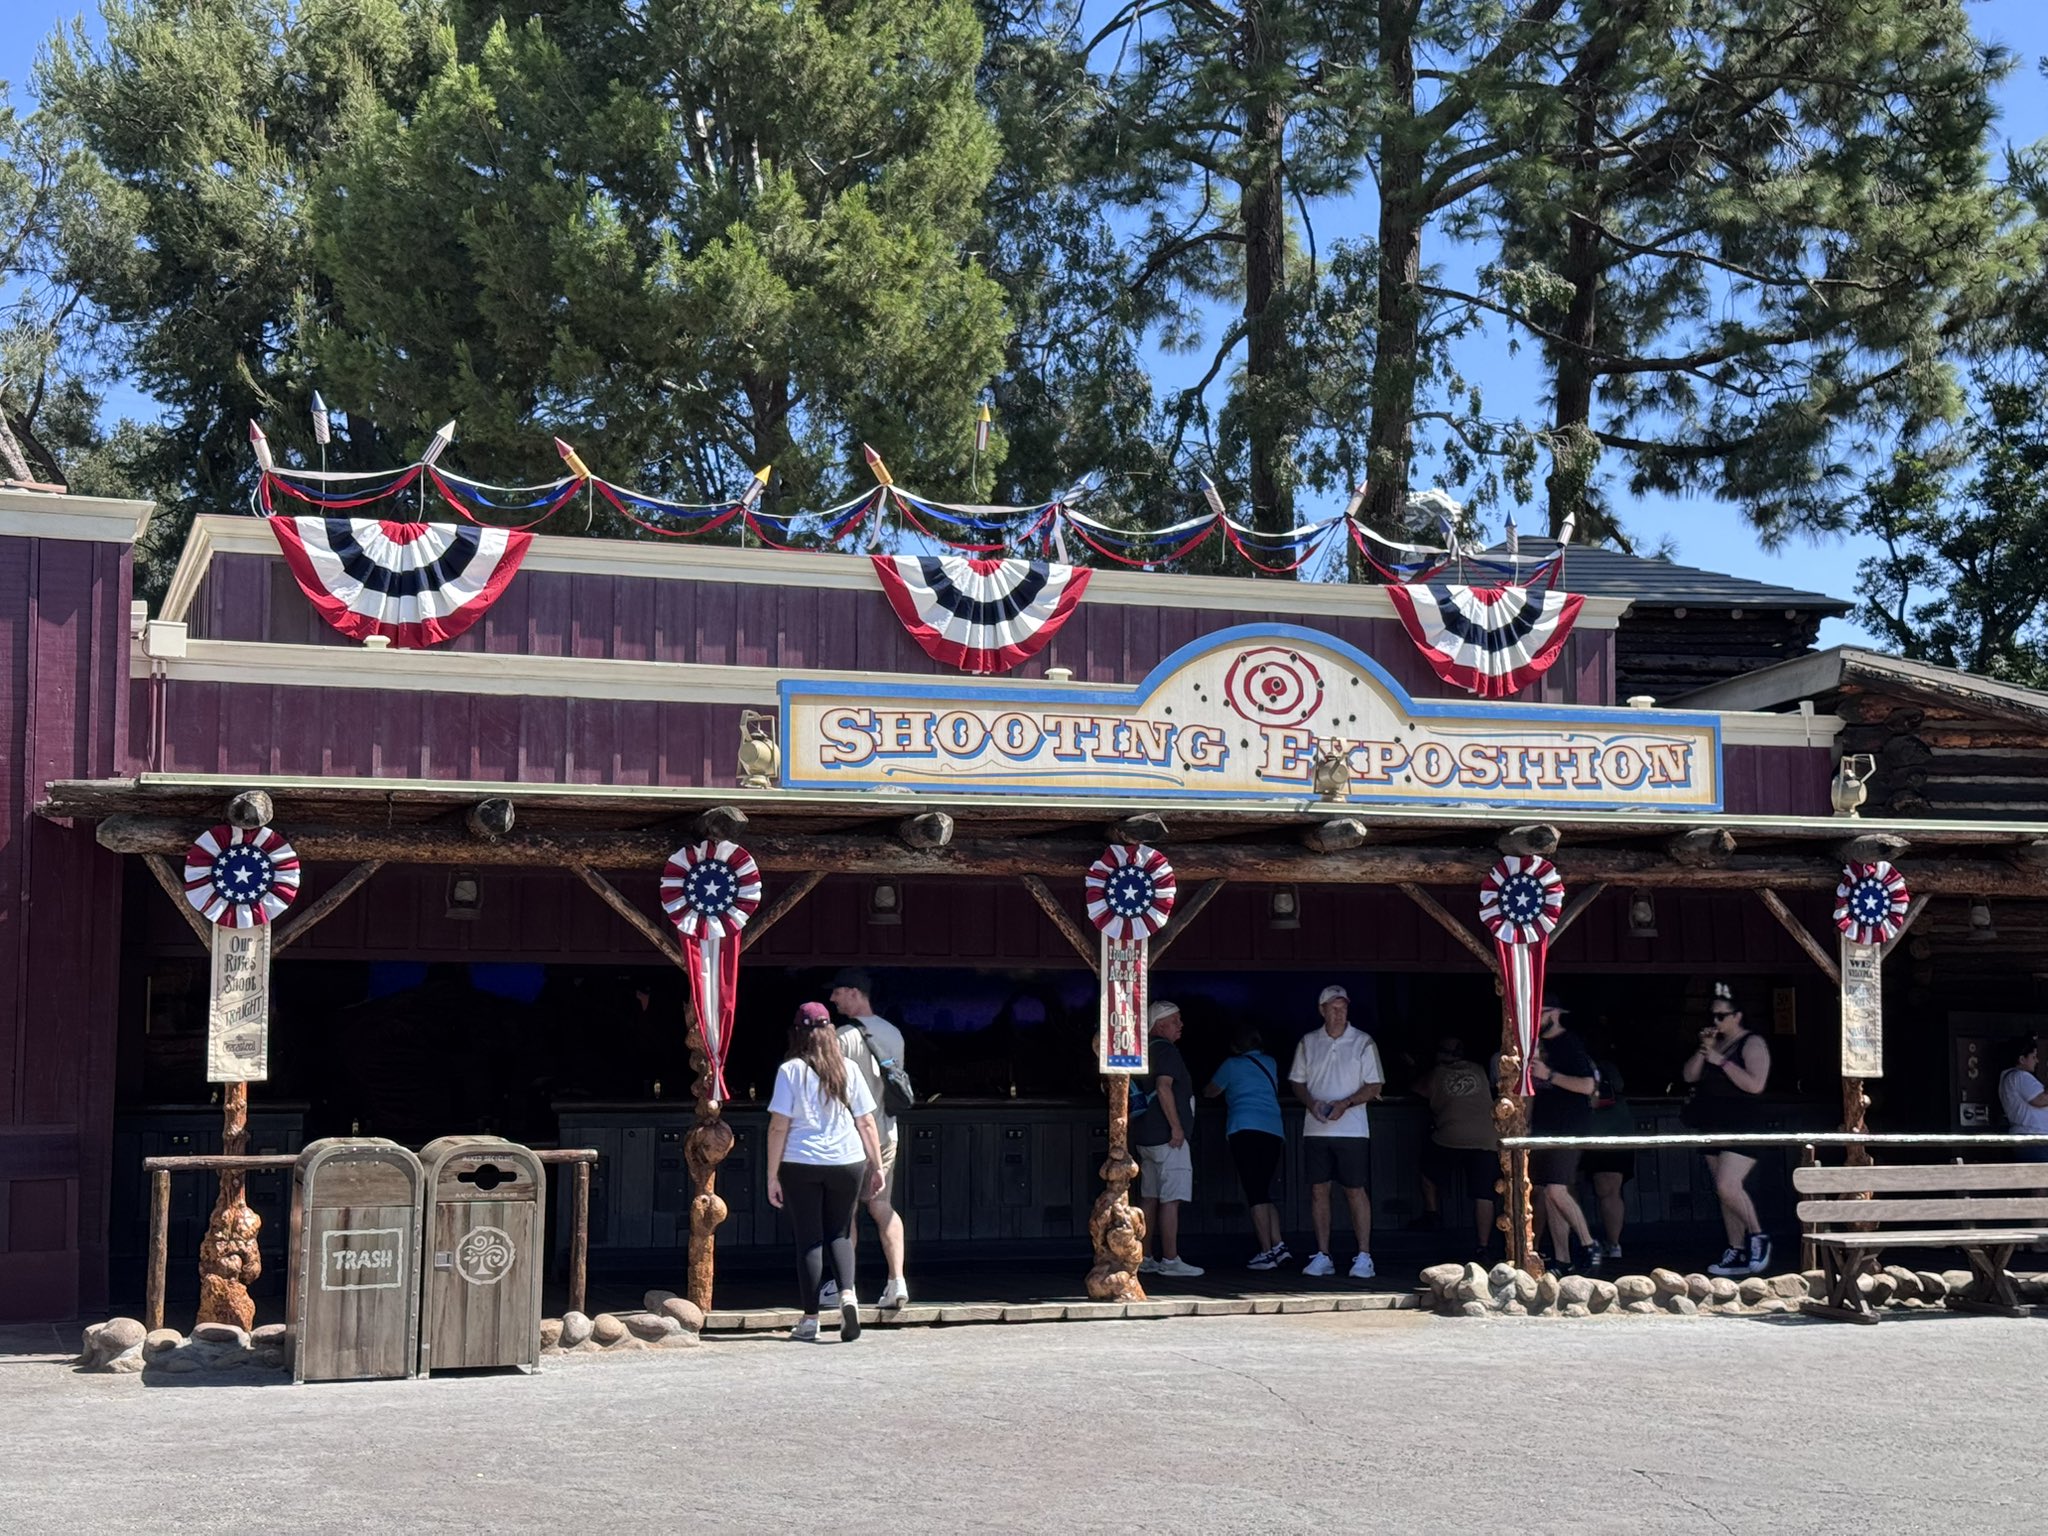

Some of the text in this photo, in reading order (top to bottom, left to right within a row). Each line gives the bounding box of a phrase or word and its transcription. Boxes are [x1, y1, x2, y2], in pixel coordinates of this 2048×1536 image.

[820, 708, 1229, 772] SHOOTING
[230, 935, 253, 953] Our
[224, 954, 256, 973] Rifles
[1849, 959, 1872, 968] WE
[1109, 965, 1138, 981] Arcade
[224, 975, 257, 994] Shoot
[1110, 1010, 1137, 1027] Only
[332, 1250, 392, 1270] TRASH
